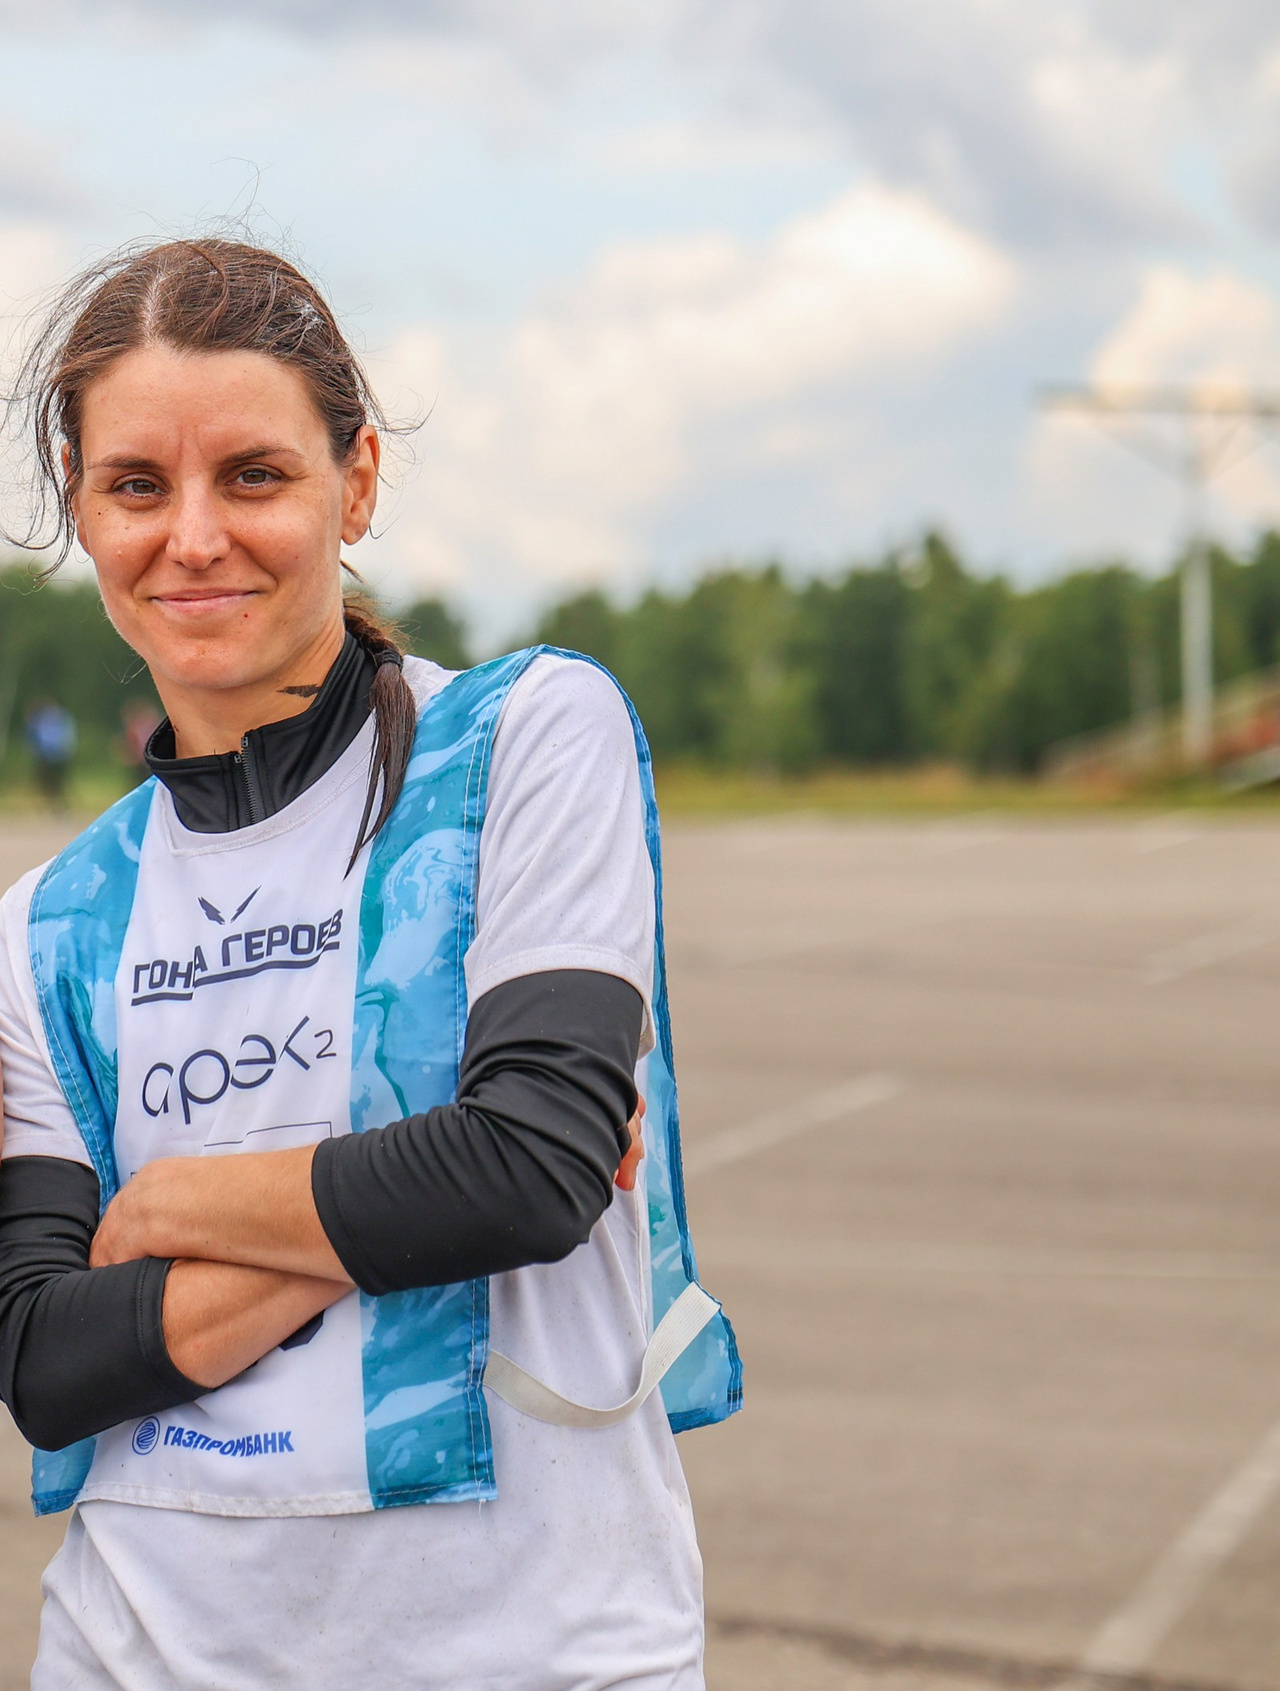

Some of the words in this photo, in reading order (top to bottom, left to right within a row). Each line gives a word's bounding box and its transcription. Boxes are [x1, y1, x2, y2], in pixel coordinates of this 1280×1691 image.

[133, 945, 208, 993] ГОНА
[221, 908, 344, 967] ГЕРОЕВ
[163, 1425, 295, 1457] ГАЗПРОМБАНК
